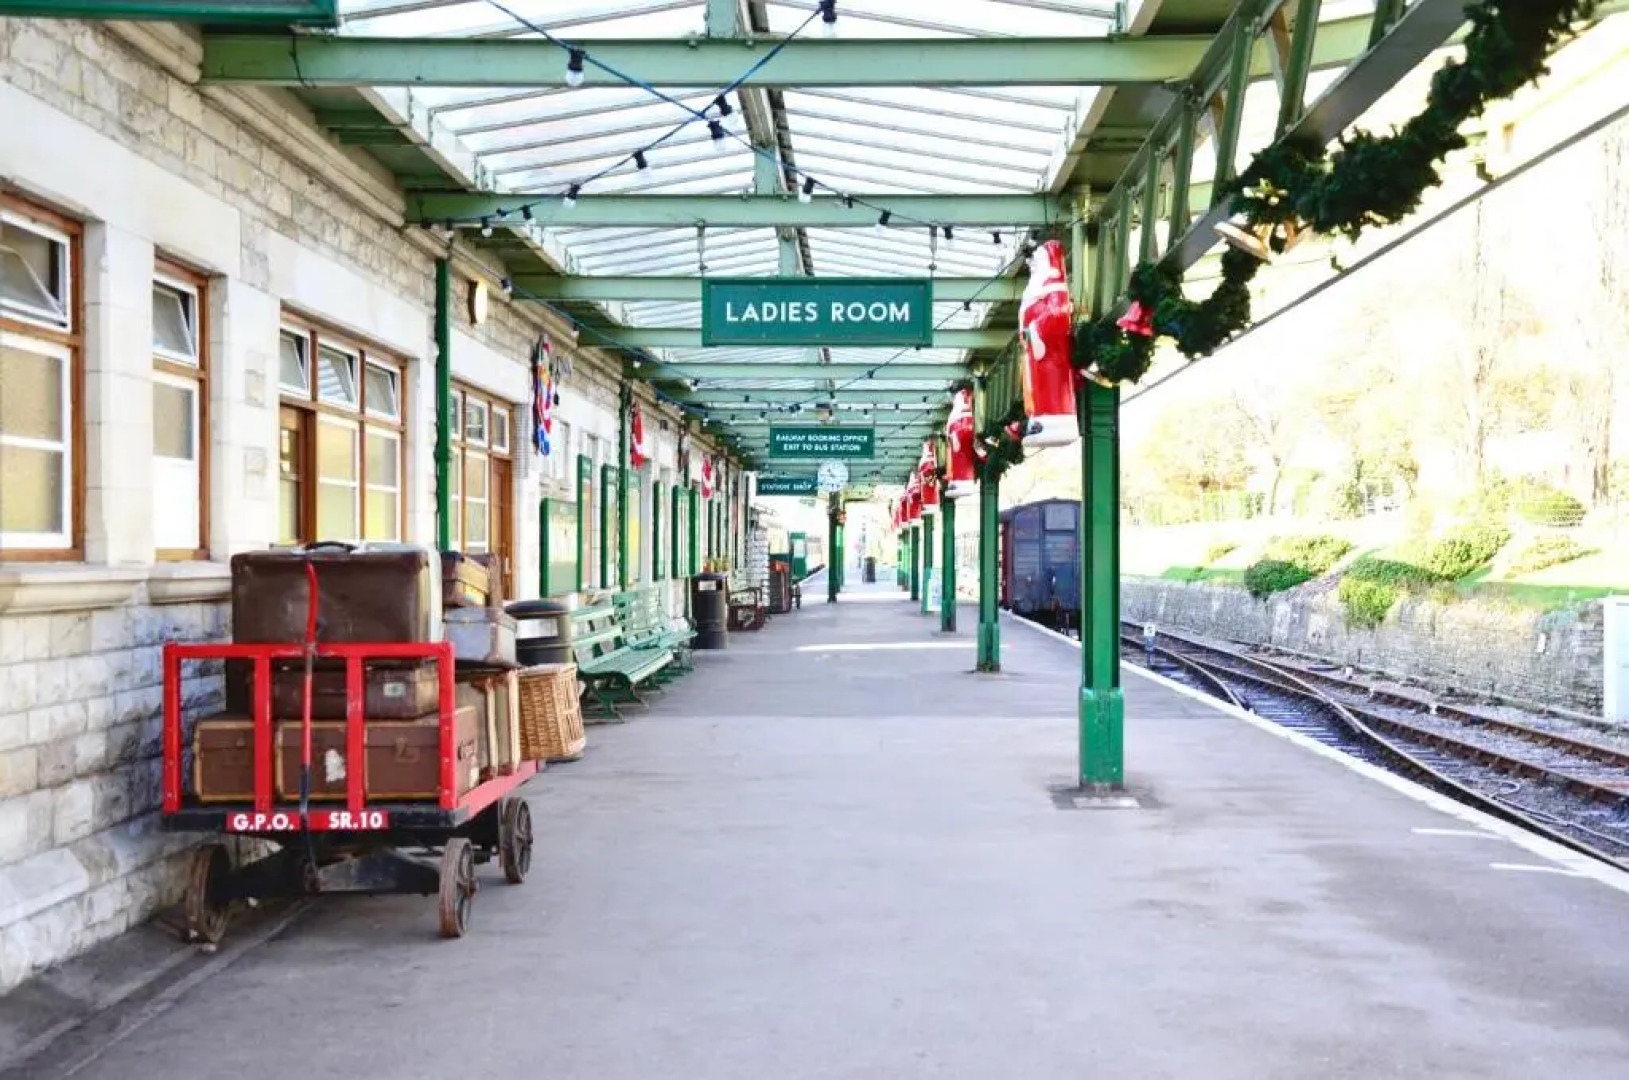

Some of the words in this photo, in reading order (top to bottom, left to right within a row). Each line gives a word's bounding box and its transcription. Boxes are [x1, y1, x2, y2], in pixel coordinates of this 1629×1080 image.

[726, 302, 817, 322] LADIES
[831, 302, 910, 322] ROOM
[776, 434, 806, 442] RAILWAY
[807, 434, 841, 442] BOOKING
[842, 434, 868, 442] OFFICE
[783, 443, 800, 451] EXIT
[802, 443, 814, 451] TO
[814, 443, 828, 451] BUS
[831, 443, 861, 451] STATION
[762, 483, 790, 491] STATION
[793, 483, 812, 491] SHOP
[233, 813, 295, 831] G.P.O.
[328, 811, 383, 829] SR.10
